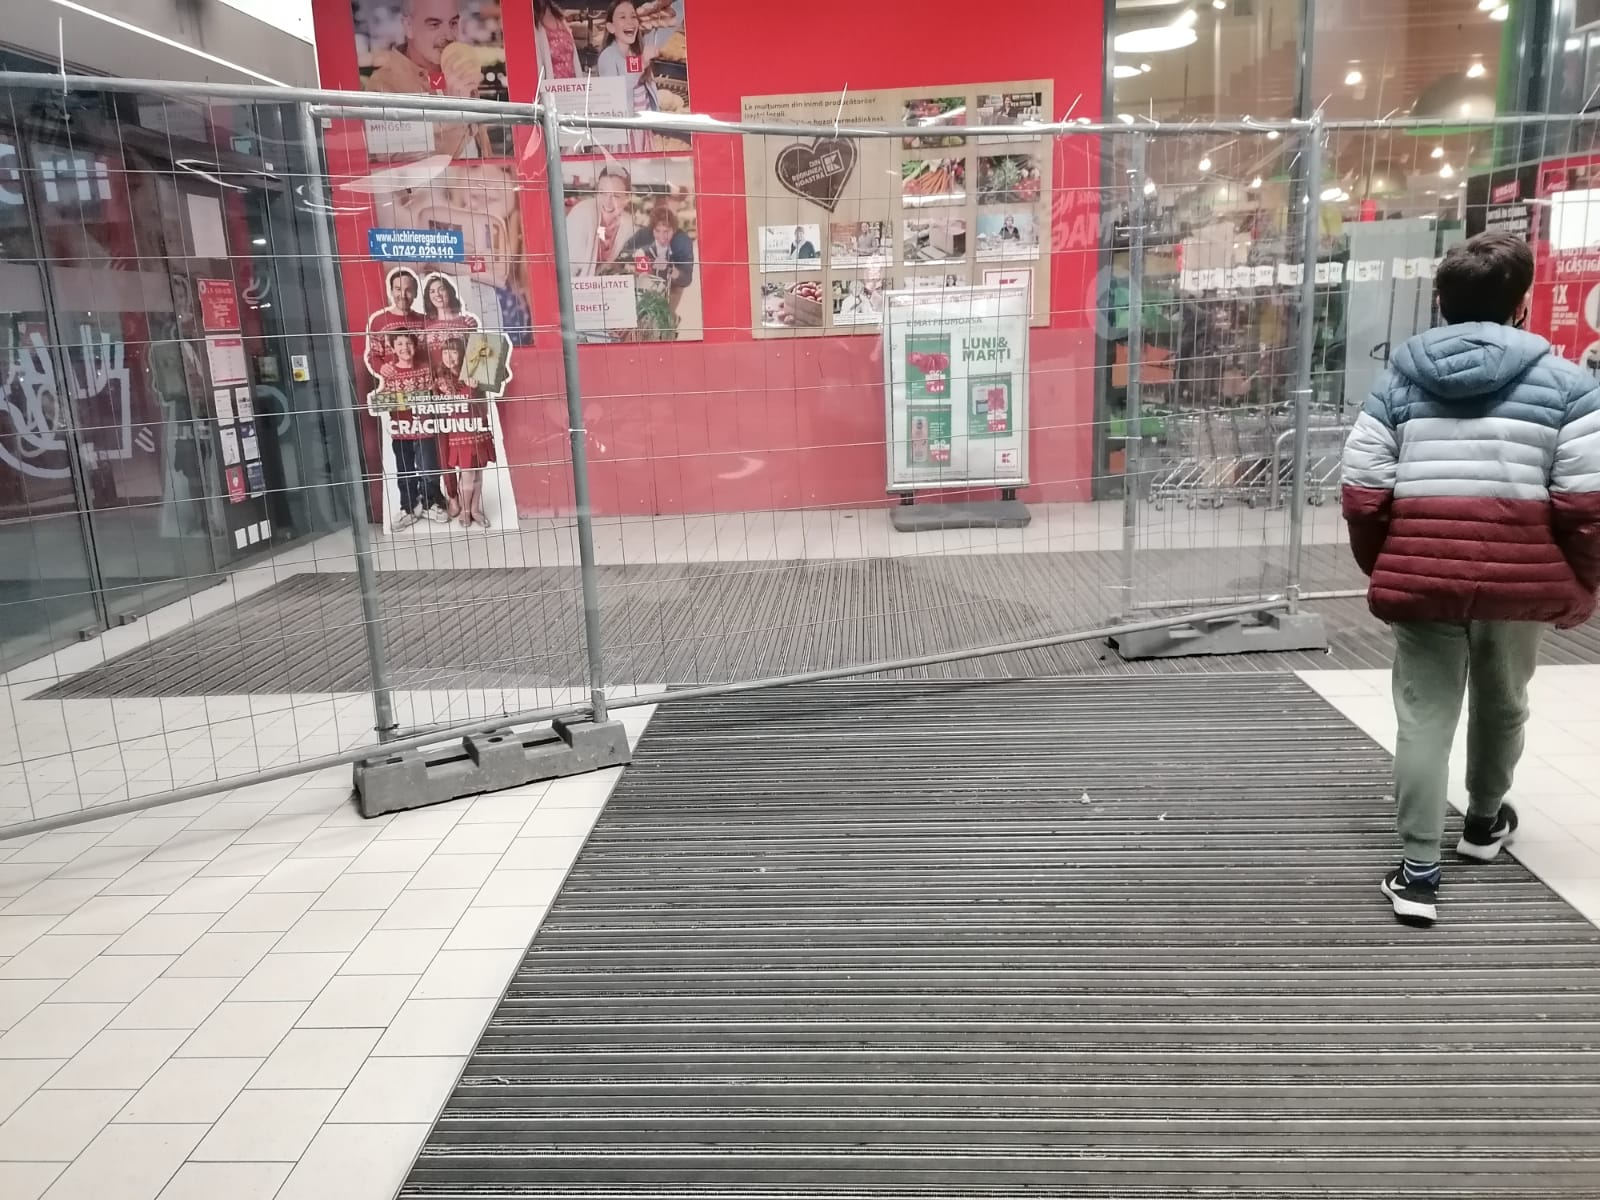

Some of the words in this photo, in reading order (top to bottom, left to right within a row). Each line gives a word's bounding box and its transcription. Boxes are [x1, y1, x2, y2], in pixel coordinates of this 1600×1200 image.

[545, 83, 593, 93] VARIETATE
[375, 231, 458, 246] www.inchirieregarduri.ro
[392, 245, 417, 257] 0742
